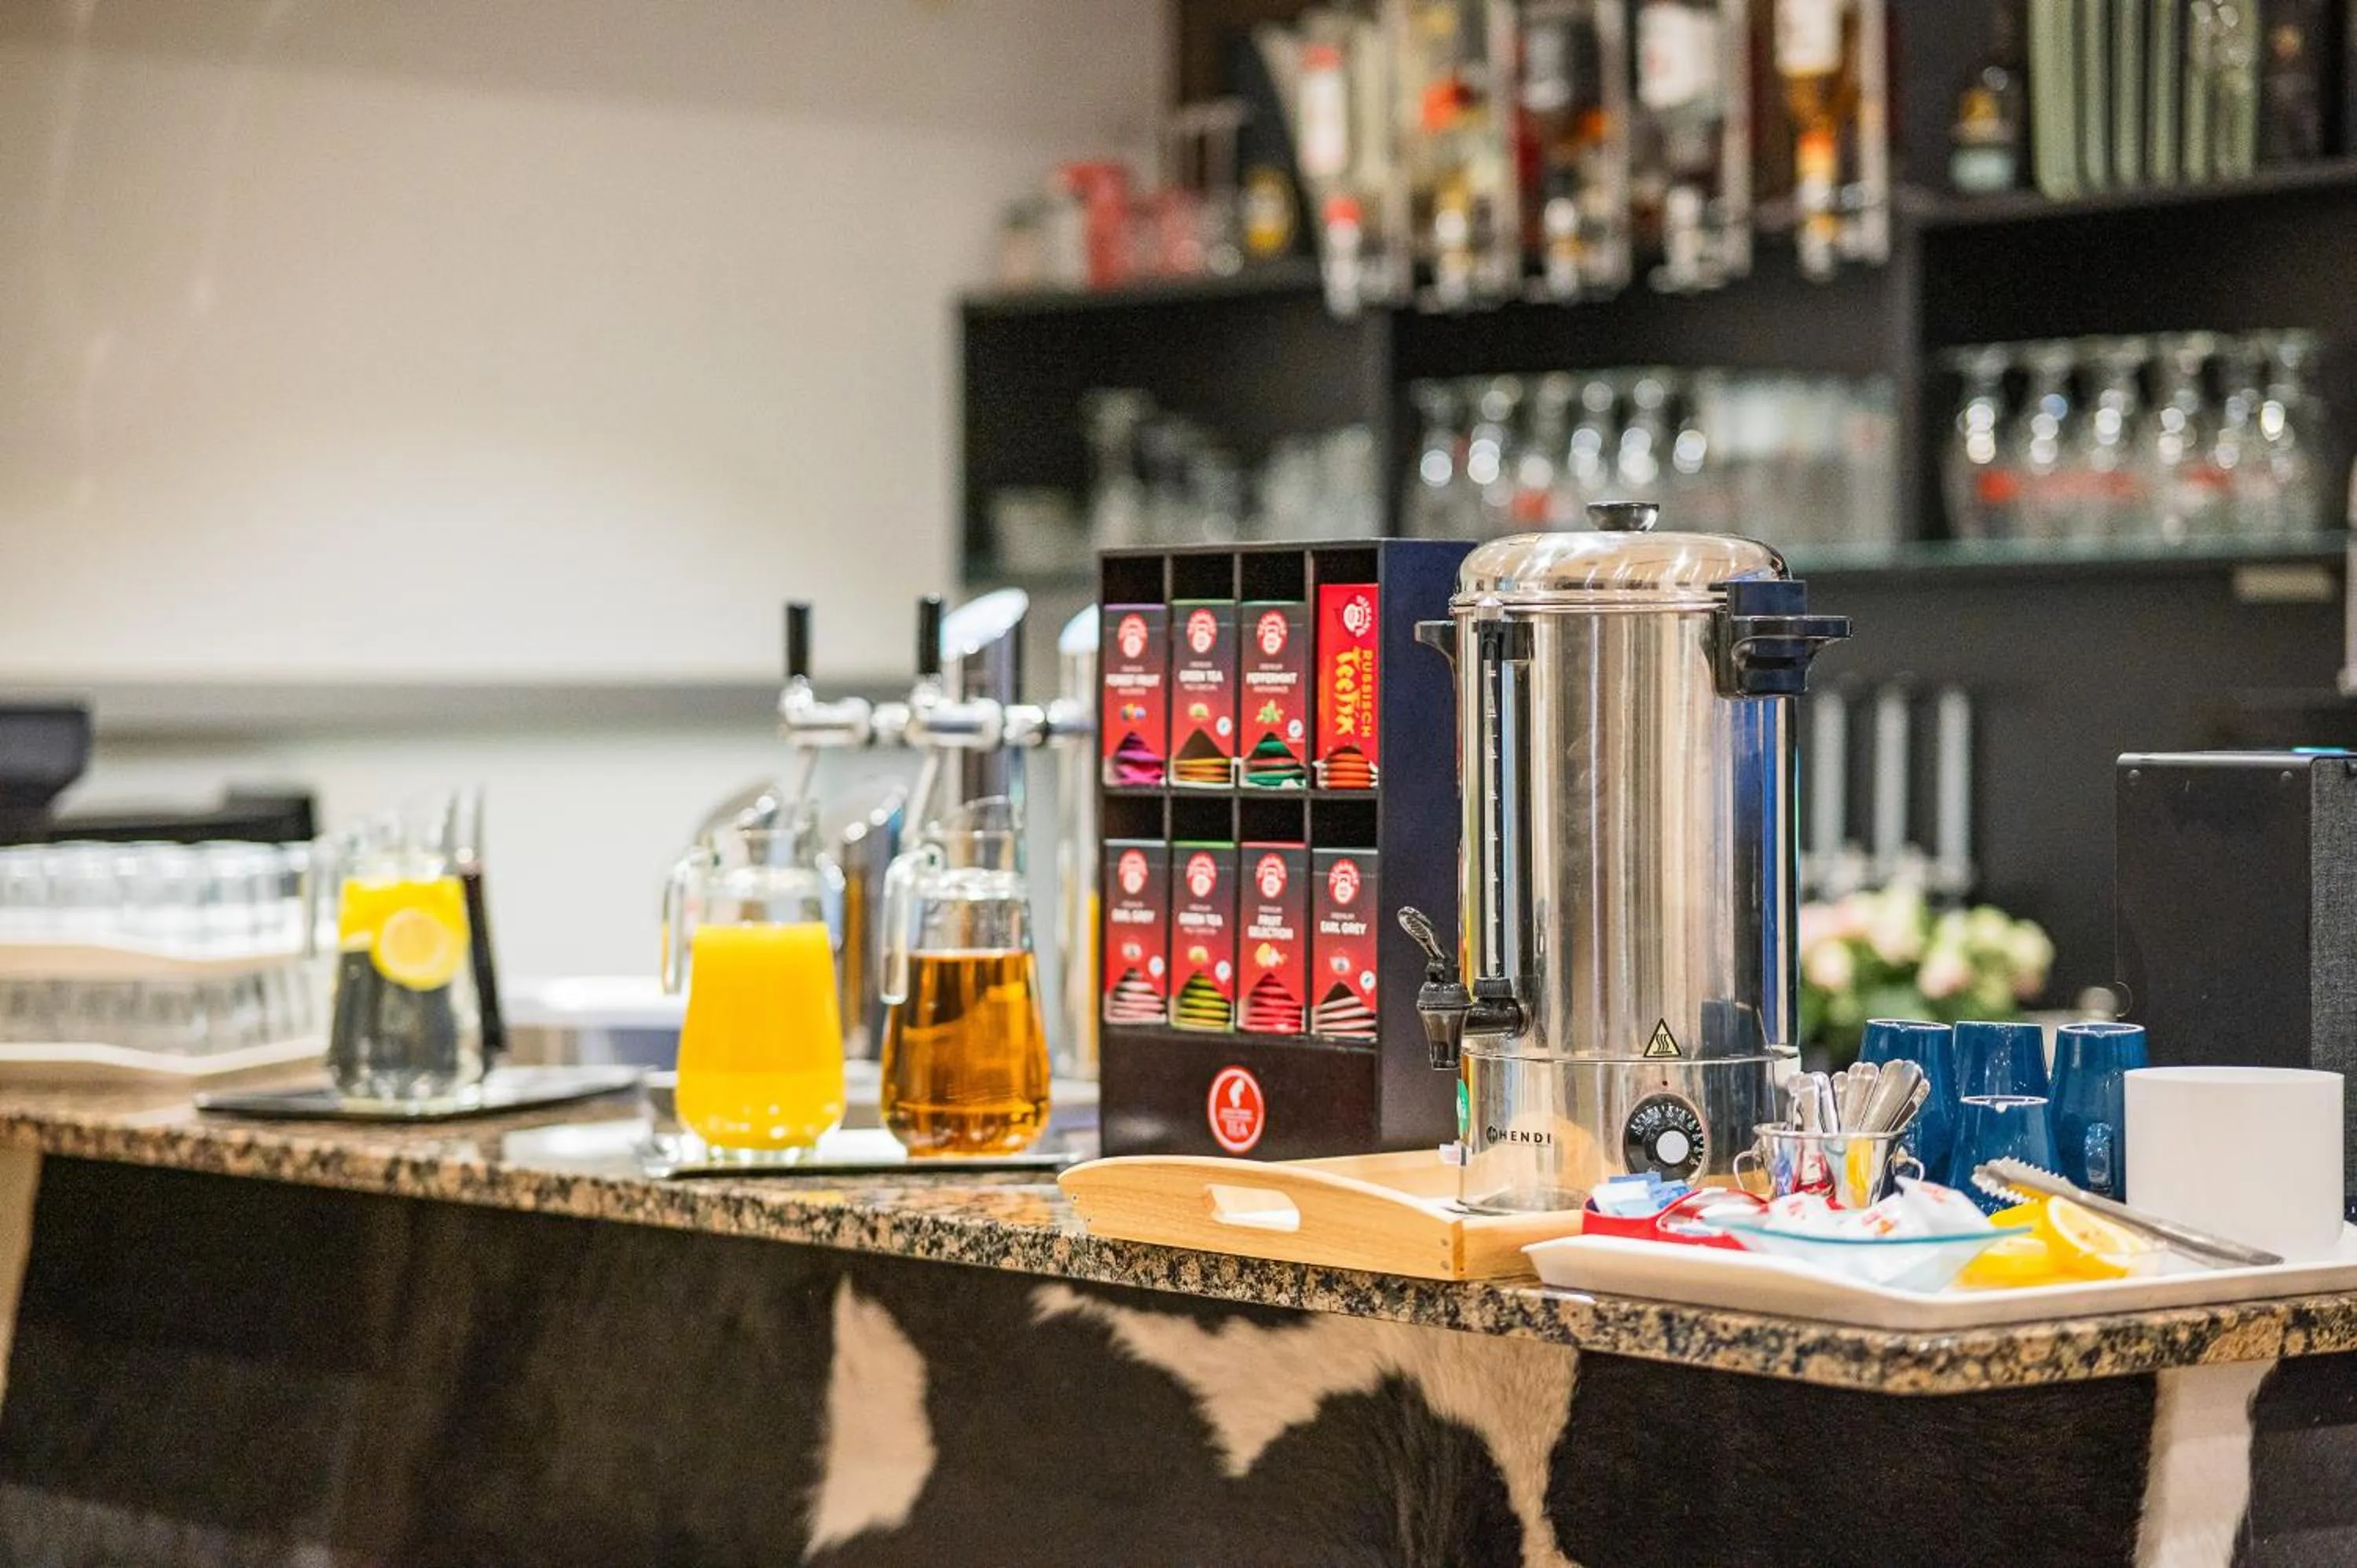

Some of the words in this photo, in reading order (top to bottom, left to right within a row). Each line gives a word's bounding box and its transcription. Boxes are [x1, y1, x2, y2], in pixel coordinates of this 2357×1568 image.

[1206, 670, 1224, 683] TEA
[1362, 650, 1373, 738] RUSSISCH
[1206, 914, 1223, 927] TEA
[1321, 920, 1340, 934] EARL
[1341, 921, 1366, 936] GREY
[1498, 1129, 1551, 1145] HENDI
